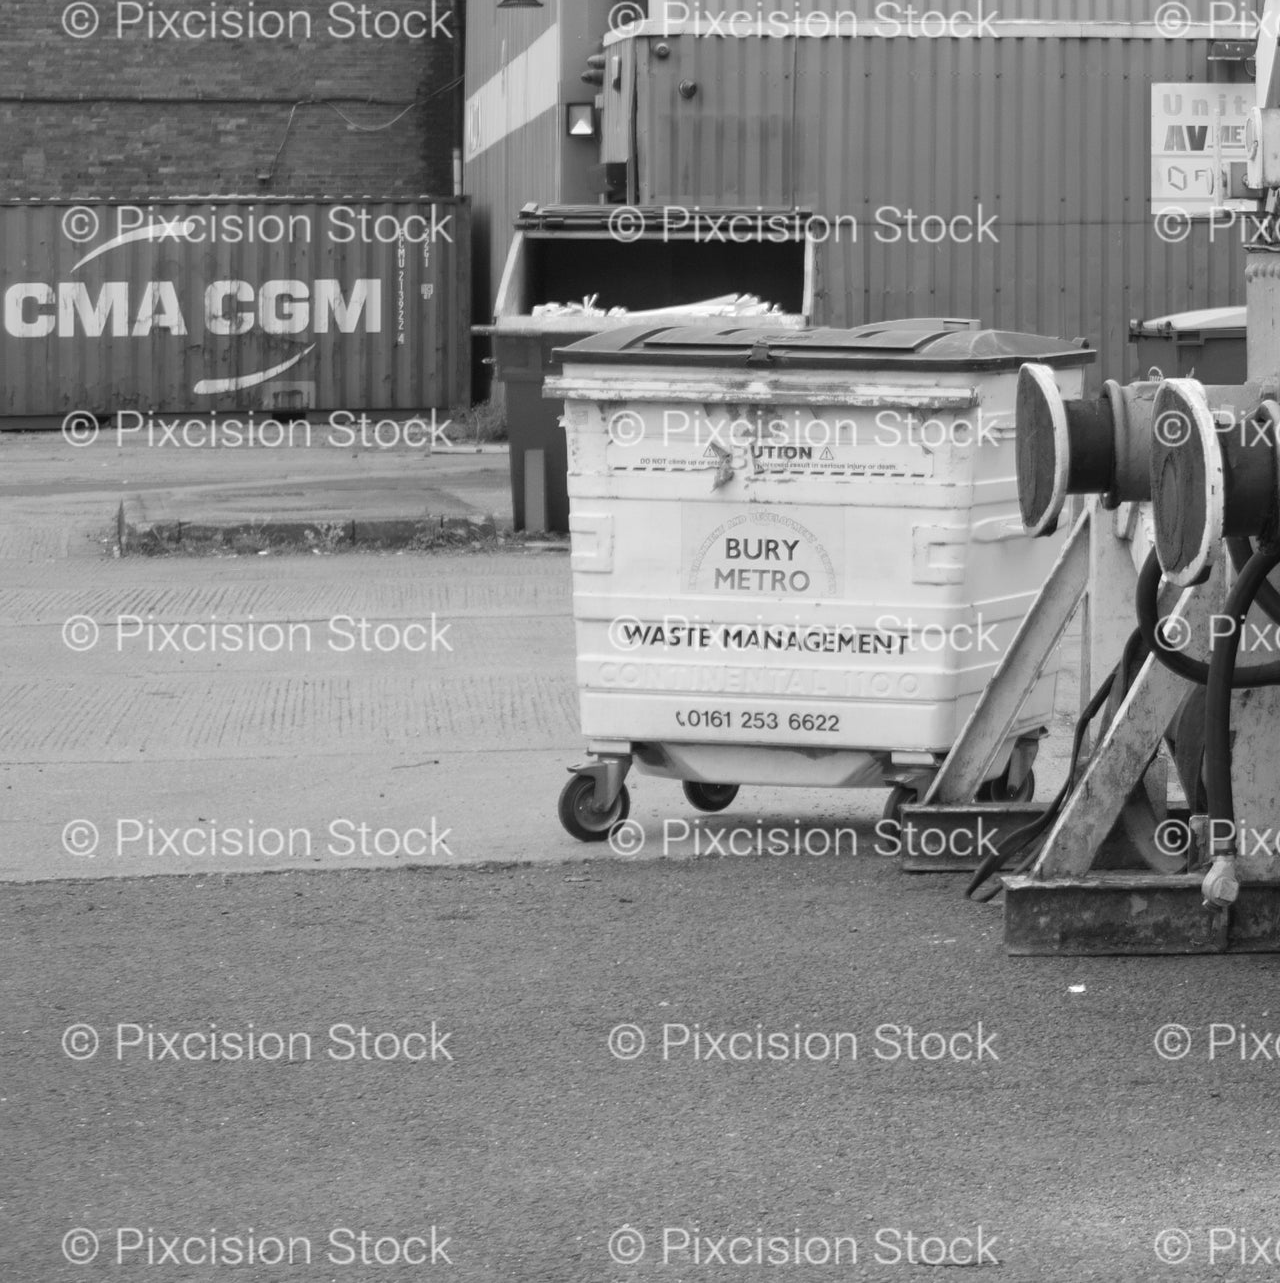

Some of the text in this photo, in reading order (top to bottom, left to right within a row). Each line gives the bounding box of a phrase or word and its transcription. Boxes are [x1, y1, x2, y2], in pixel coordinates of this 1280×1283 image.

[1163, 94, 1247, 116] Unit
[4, 279, 381, 337] CMA CGM
[751, 445, 813, 460] UTION
[847, 463, 866, 472] injury
[725, 537, 800, 561] BURY
[714, 567, 811, 593] METRO
[623, 624, 909, 656] WASTE MANAGEMENT
[687, 709, 840, 733] 0161 253 6622
